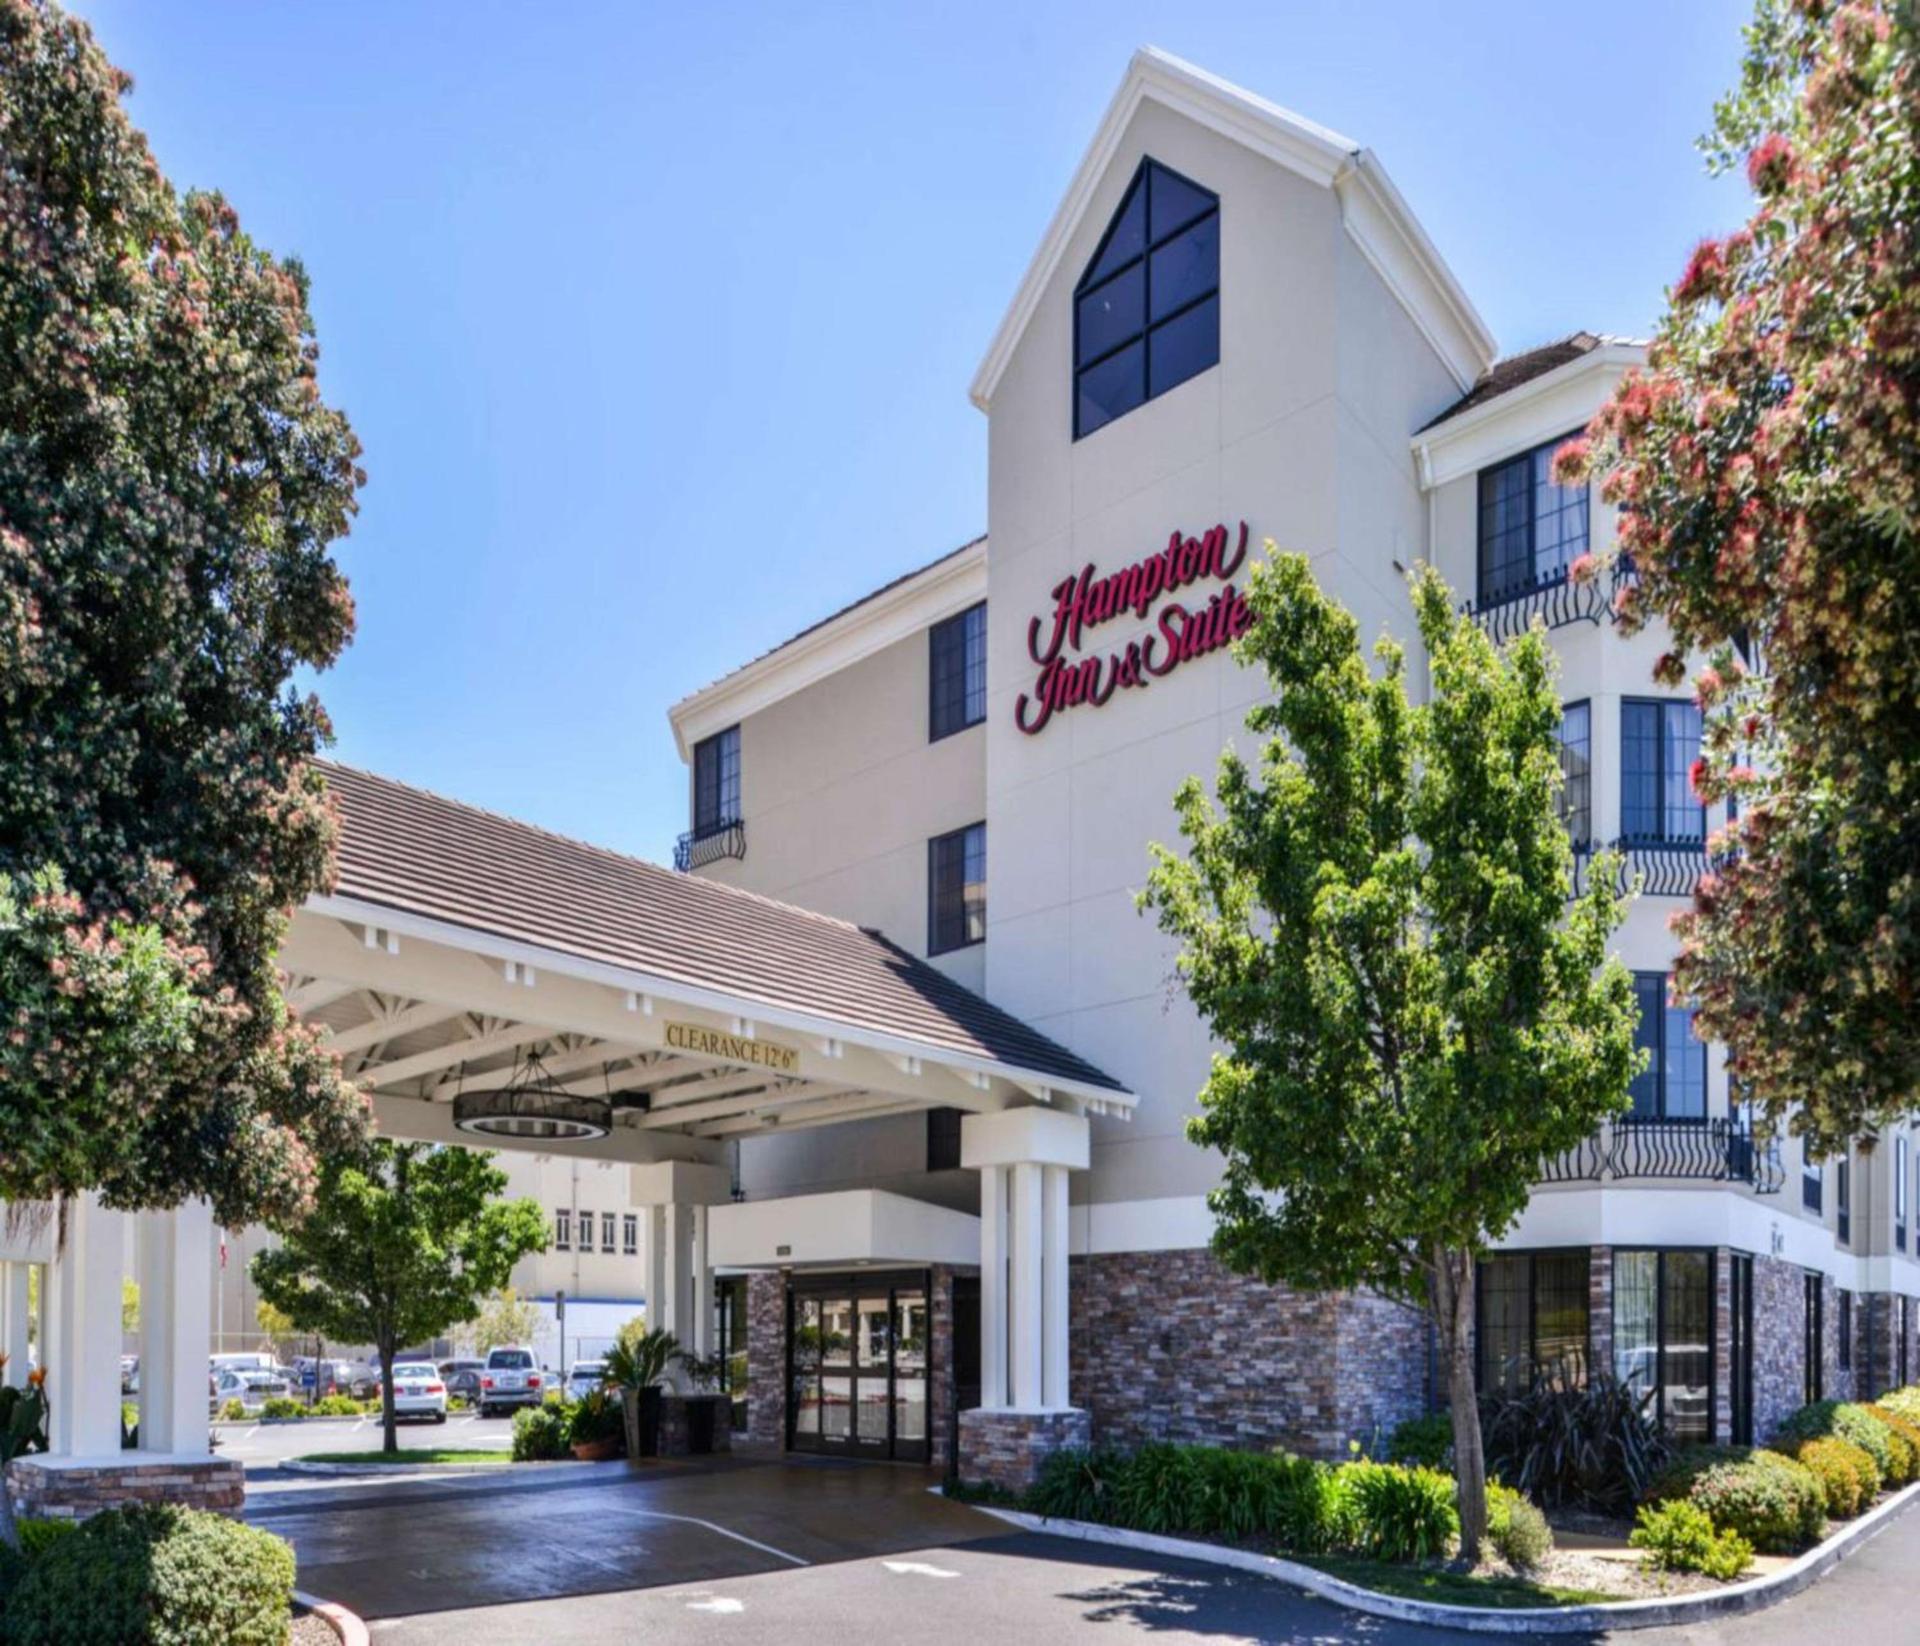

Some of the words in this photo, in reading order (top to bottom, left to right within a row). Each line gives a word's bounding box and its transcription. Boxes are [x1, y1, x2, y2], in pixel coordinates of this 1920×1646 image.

[1027, 519, 1249, 666] Hampton
[1015, 656, 1120, 735] Inn
[1116, 641, 1149, 688] &
[666, 1023, 760, 1064] CLEARANCE
